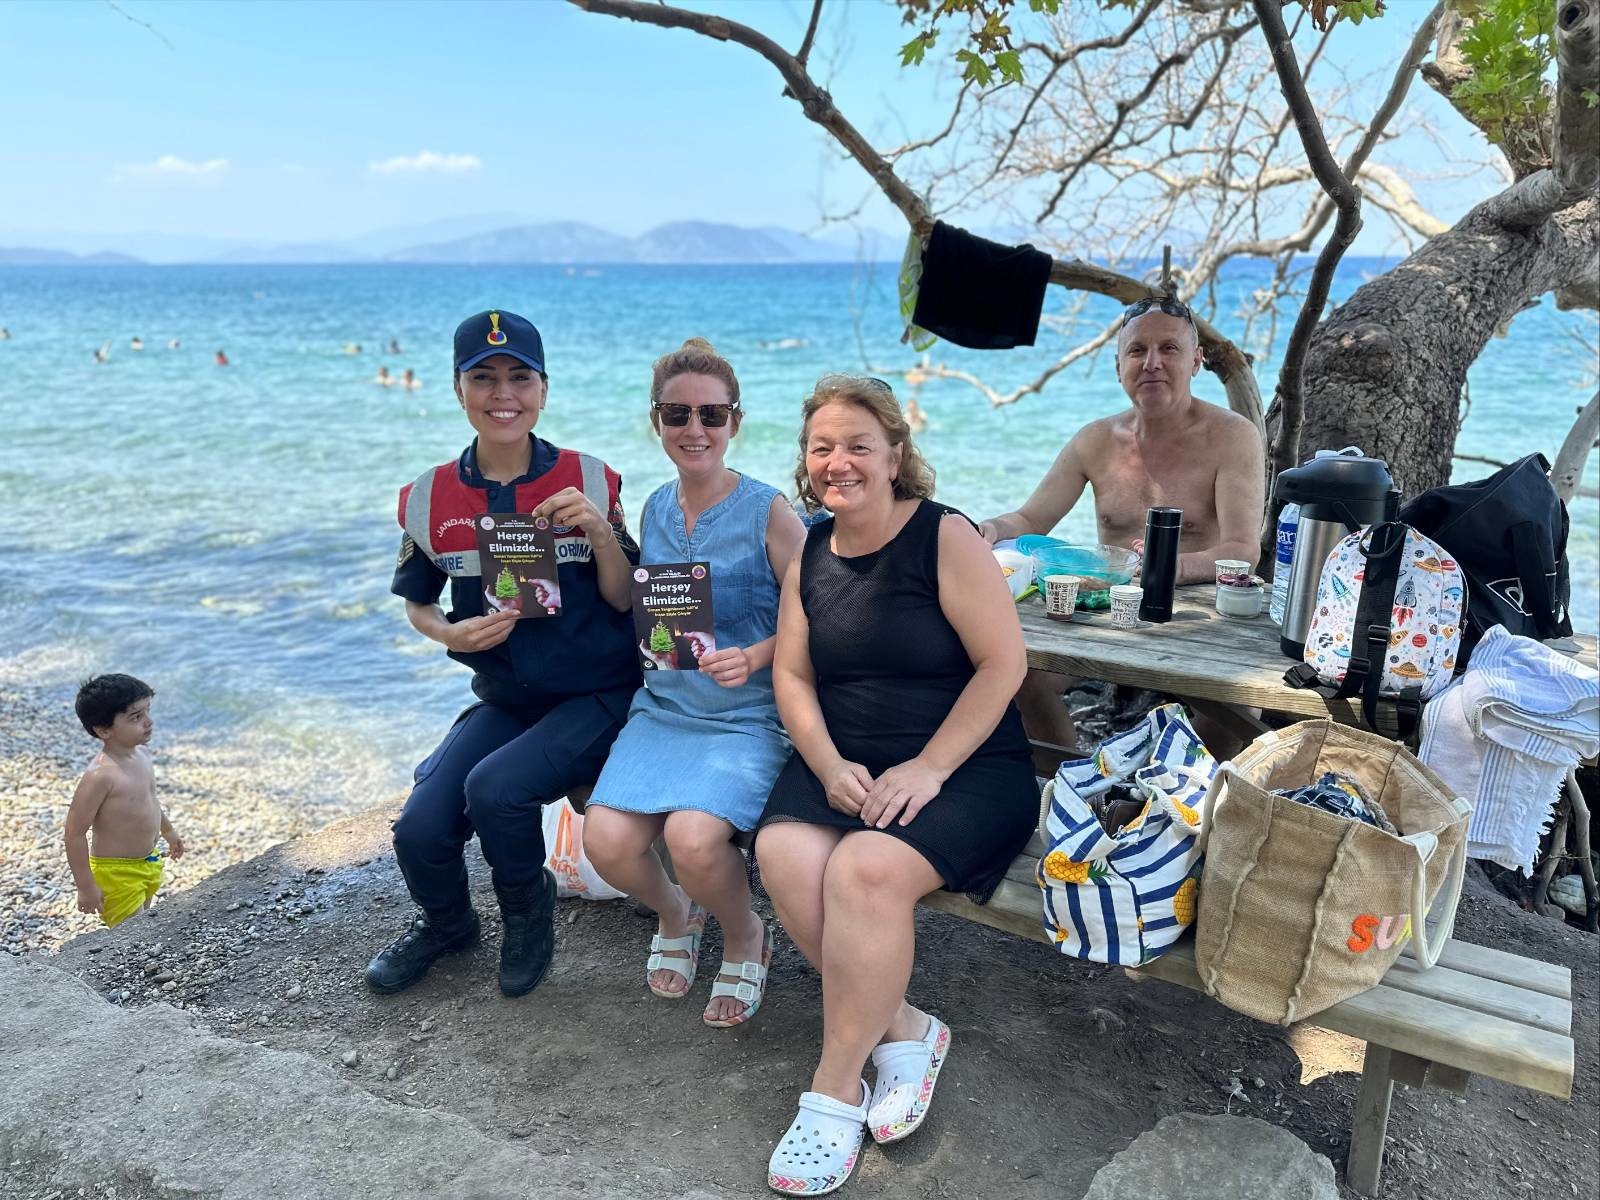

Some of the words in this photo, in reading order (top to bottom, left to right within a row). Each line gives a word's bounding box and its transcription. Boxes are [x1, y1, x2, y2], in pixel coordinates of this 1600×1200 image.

[496, 531, 535, 542] Herşey
[489, 543, 545, 553] Elimizde...
[555, 543, 593, 558] ORUM
[651, 583, 691, 593] Herşey
[642, 594, 702, 606] Elimizde...
